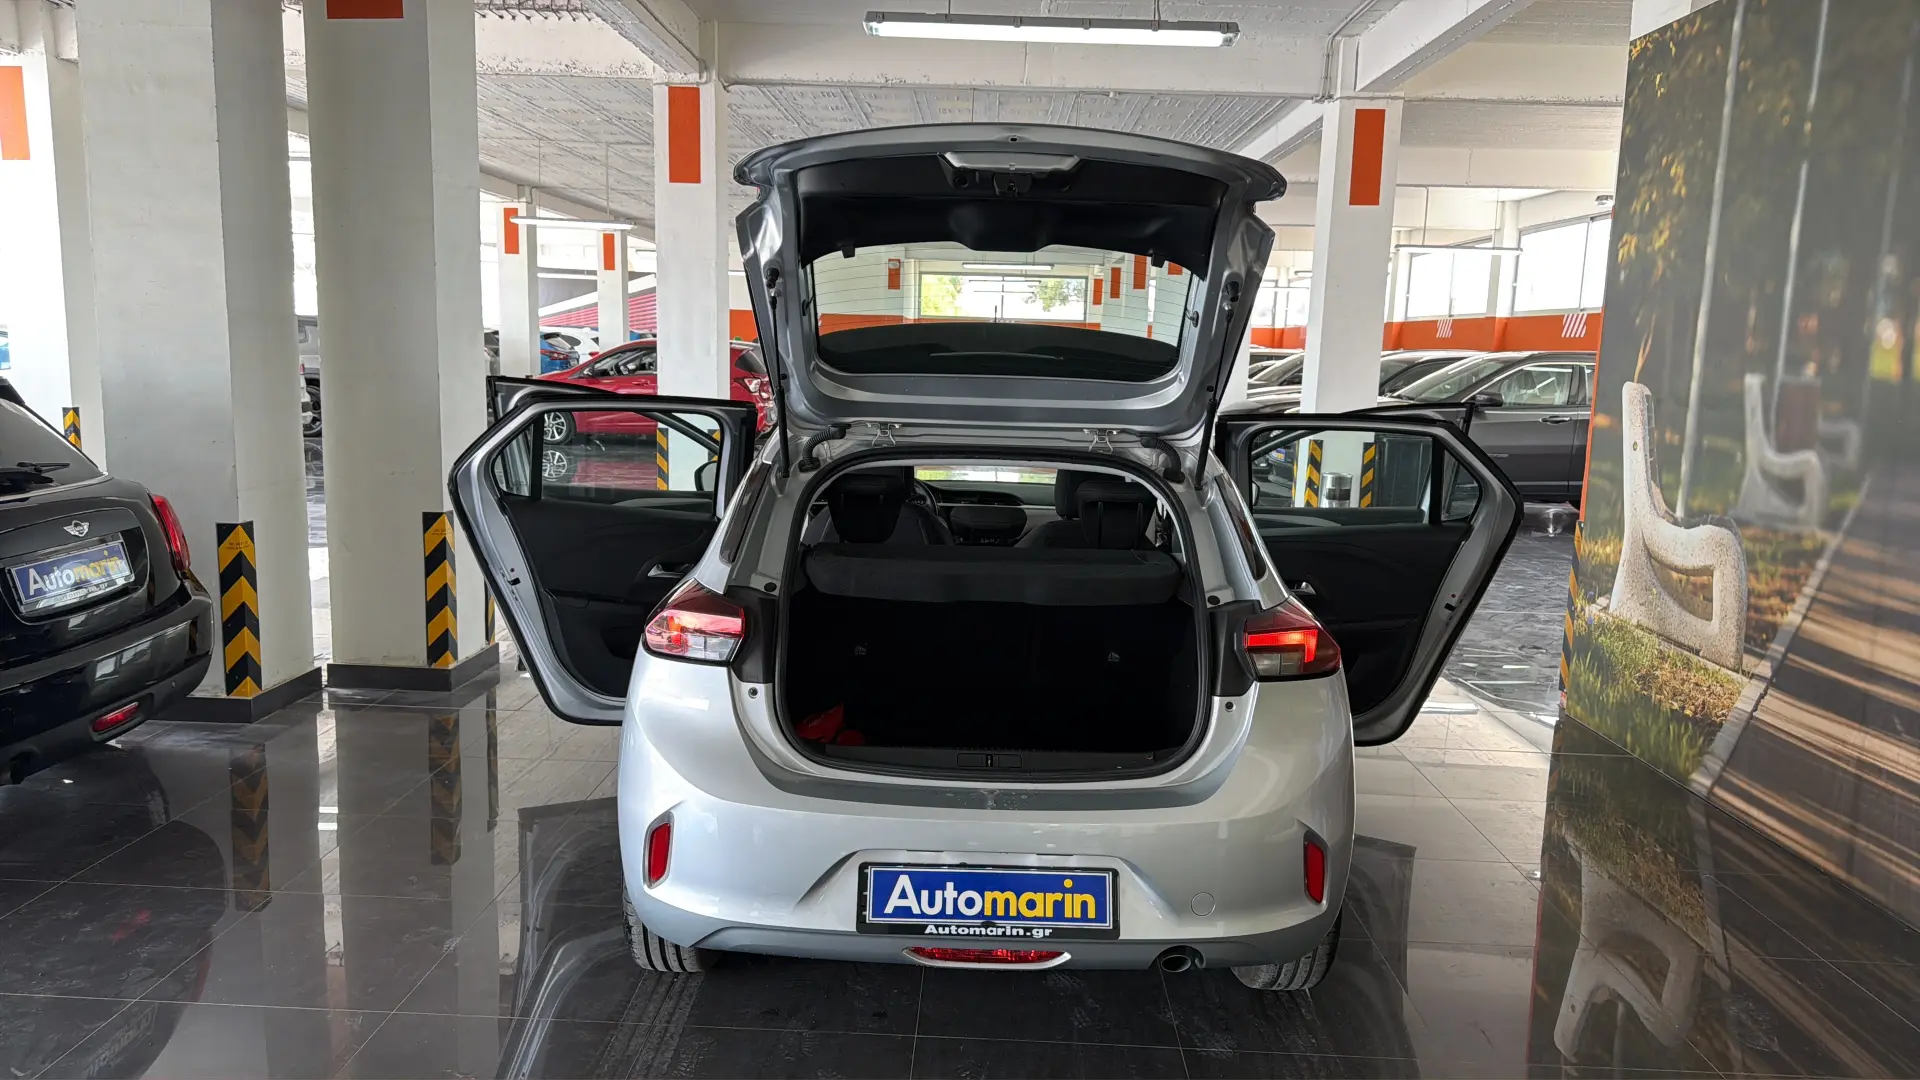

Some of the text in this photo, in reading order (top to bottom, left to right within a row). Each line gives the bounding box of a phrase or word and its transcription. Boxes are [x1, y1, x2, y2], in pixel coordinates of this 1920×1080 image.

[29, 550, 120, 596] Automarin
[884, 874, 1096, 919] Automarin
[924, 924, 1053, 938] Automarin.gr
